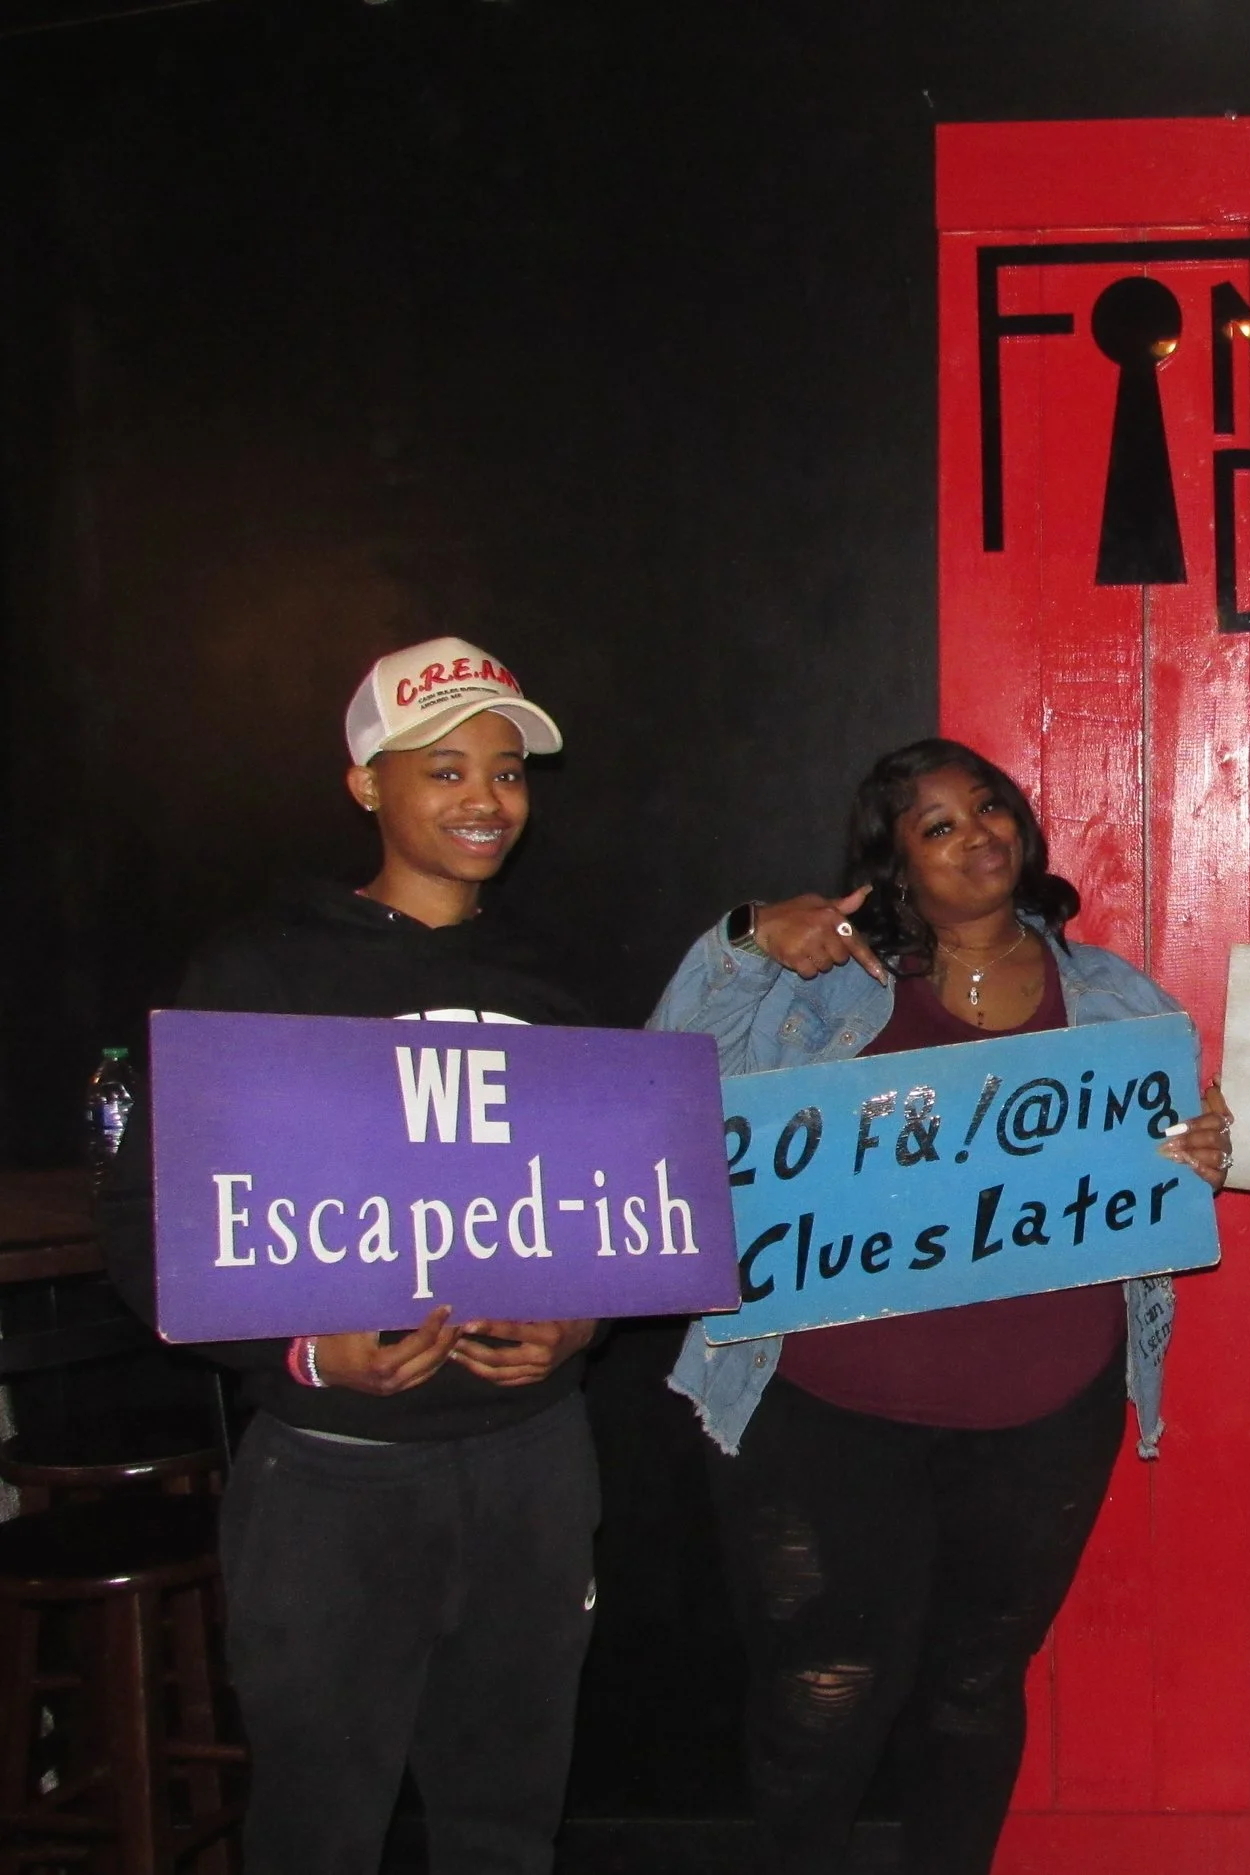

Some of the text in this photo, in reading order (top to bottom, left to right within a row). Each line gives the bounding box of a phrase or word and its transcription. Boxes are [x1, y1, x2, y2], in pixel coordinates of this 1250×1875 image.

[395, 1046, 512, 1143] WE
[723, 1106, 823, 1187] 20
[212, 1154, 700, 1299] Escaped-ish
[739, 1174, 1180, 1304] Clues Later
